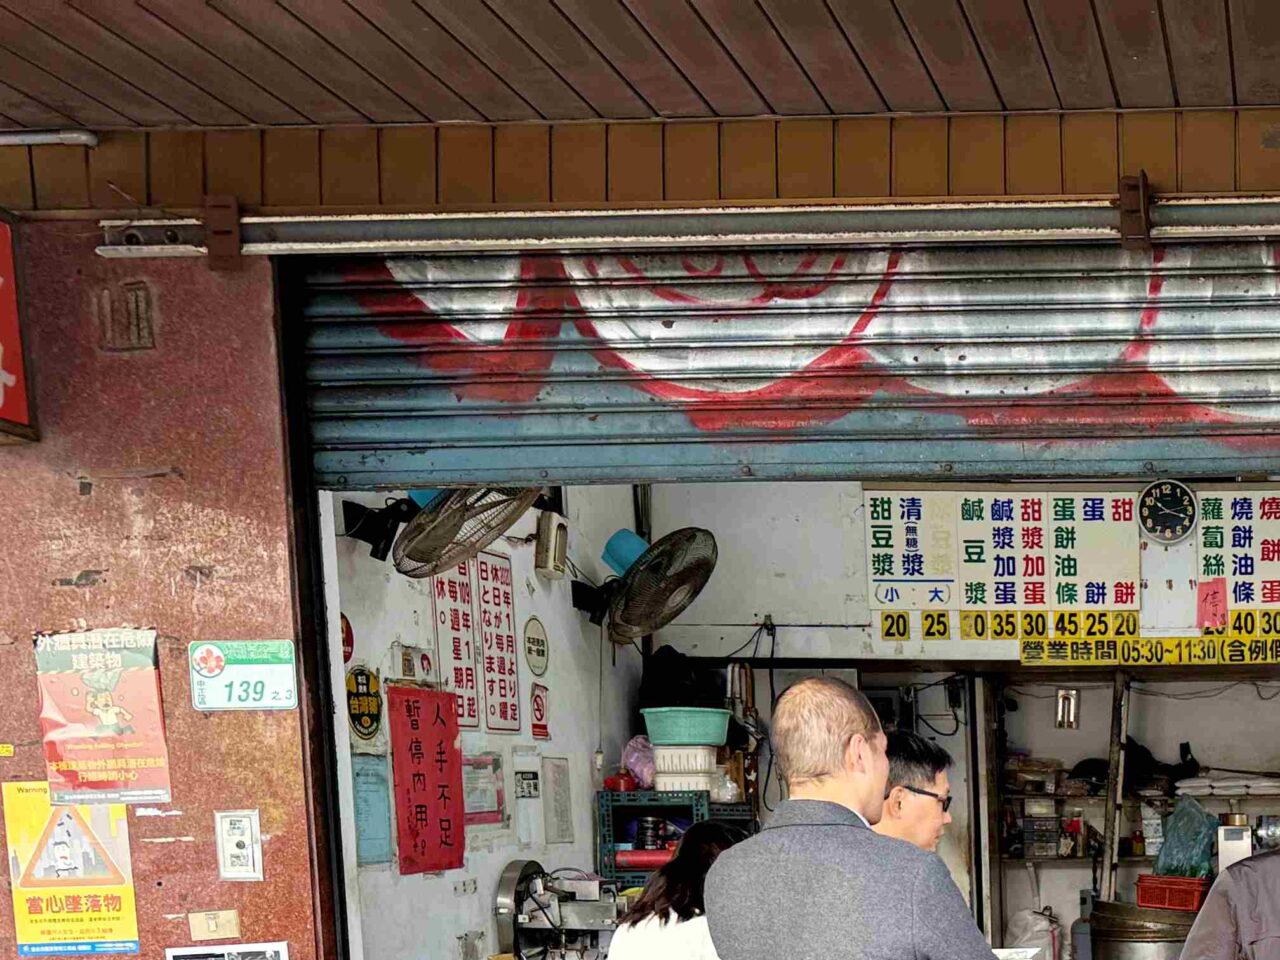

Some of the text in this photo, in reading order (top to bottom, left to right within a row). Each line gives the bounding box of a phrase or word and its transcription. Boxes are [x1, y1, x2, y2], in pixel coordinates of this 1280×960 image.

[1162, 485, 1171, 494] 12
[1142, 508, 1148, 516] 9
[1183, 518, 1190, 526] 4
[1187, 506, 1193, 515] 3
[870, 497, 894, 576] 甜豆漿
[1156, 526, 1161, 534] 7
[1165, 529, 1171, 538] 6
[1176, 526, 1182, 535] 5
[961, 498, 987, 605] 鹹豆漿
[991, 498, 1017, 605] 鹹漿加蛋
[1021, 498, 1046, 605] 甜漿加蛋
[1053, 497, 1078, 605] 蛋餅油條
[1231, 498, 1254, 604] 燒餅油條
[884, 613, 907, 637] 20
[924, 613, 947, 637] 25
[993, 613, 1016, 637] 35
[1024, 613, 1046, 637] 30
[1055, 612, 1078, 637] 45
[1086, 612, 1109, 636] 25
[1114, 612, 1137, 636] 20
[1233, 612, 1255, 635] 40
[1022, 640, 1118, 661] 營業時間
[224, 680, 265, 702] 139
[432, 703, 454, 848] 人手不足
[17, 786, 47, 794] Warning
[26, 894, 122, 915] 當心墜落物
